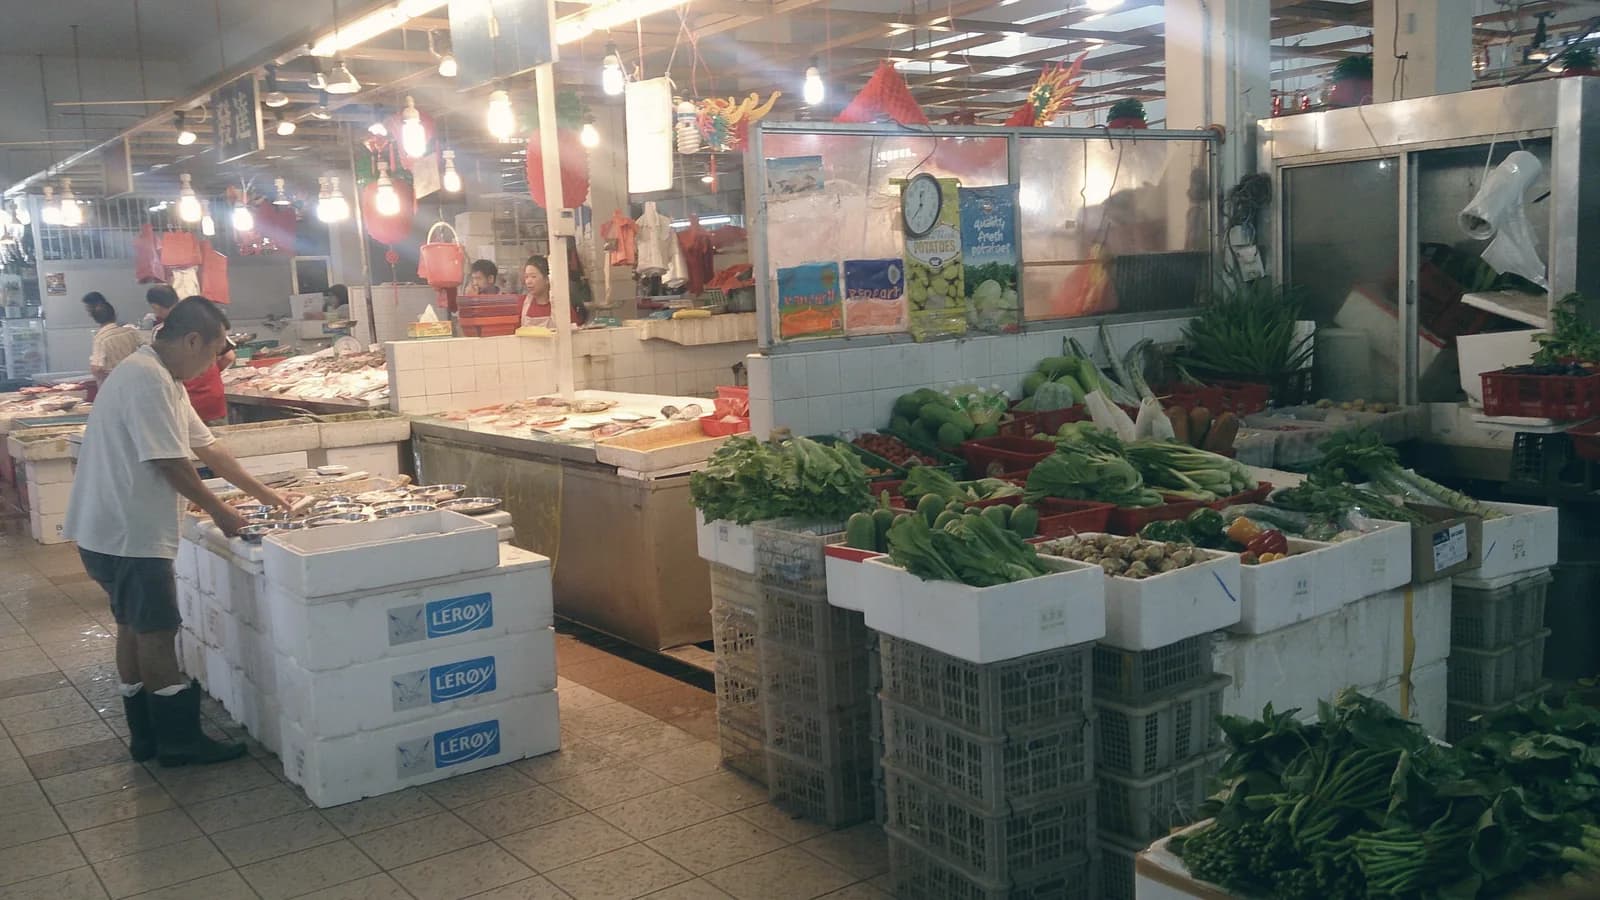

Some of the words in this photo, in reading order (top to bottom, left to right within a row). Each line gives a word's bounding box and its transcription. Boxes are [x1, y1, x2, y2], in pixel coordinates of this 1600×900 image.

[973, 215, 1006, 231] quality
[977, 229, 1004, 243] fresh
[913, 239, 956, 254] POTATOES
[971, 242, 1011, 257] potatoes
[432, 602, 487, 626] LERØY
[435, 666, 490, 690] LERØY
[440, 730, 495, 756] LERØY
